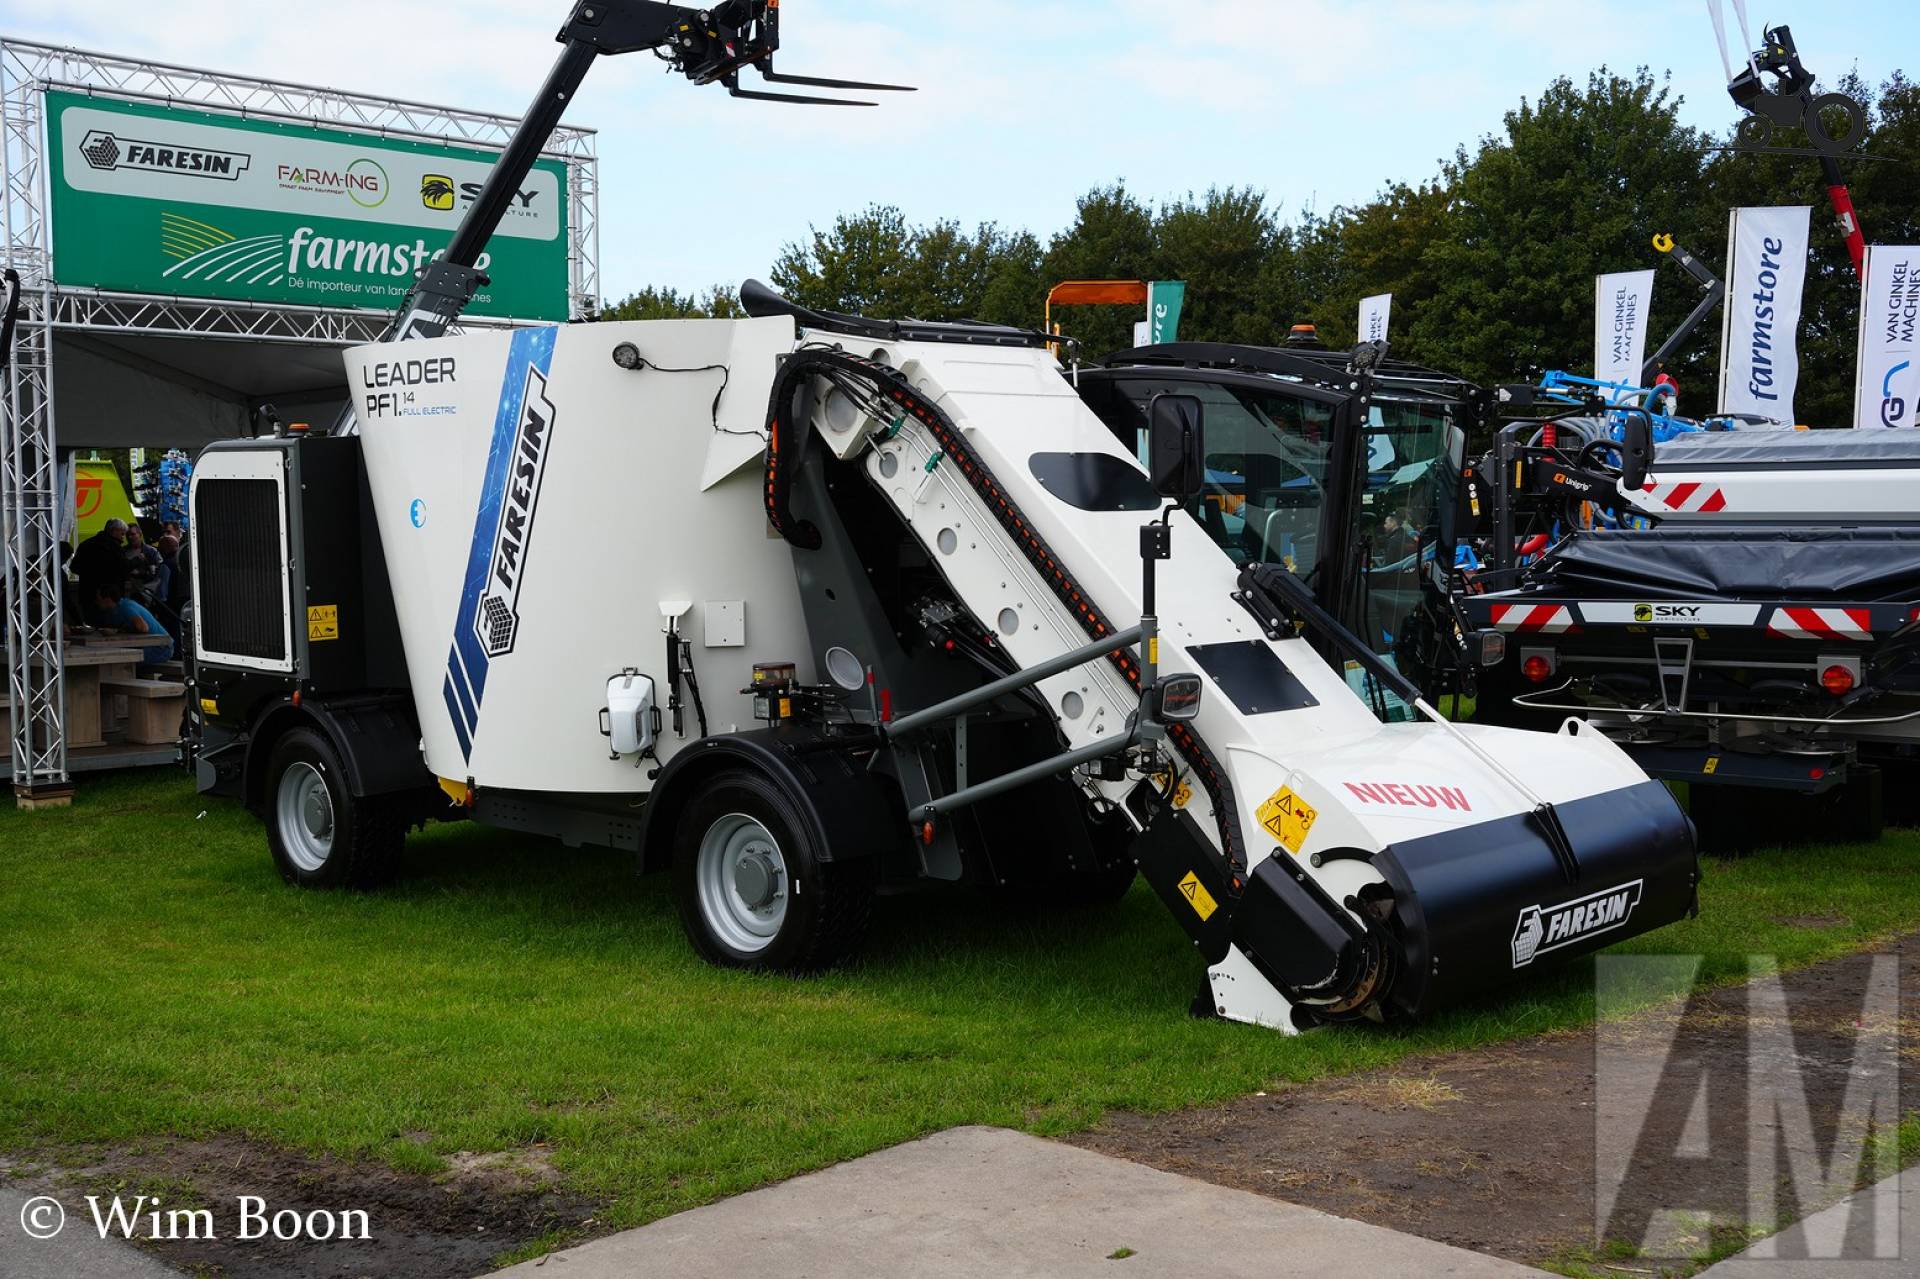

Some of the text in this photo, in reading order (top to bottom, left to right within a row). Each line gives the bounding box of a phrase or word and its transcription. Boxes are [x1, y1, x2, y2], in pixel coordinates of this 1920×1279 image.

[126, 145, 232, 174] FARESIN
[278, 165, 378, 191] FARM-ING
[460, 183, 540, 208] SY
[288, 277, 304, 288] Dé
[306, 280, 362, 294] importeur
[365, 284, 385, 295] van
[1886, 260, 1909, 344] VAN GINKEL
[1901, 269, 1920, 343] MACHINES
[1613, 285, 1627, 364] VAN GINKEL
[1750, 237, 1783, 400] farmstore
[363, 357, 456, 388] LEADER
[366, 391, 415, 418] PF1. 14
[403, 406, 457, 416] FULL ELECTRIC
[496, 405, 546, 592] FARESIN
[1655, 605, 1701, 617] SKY
[1343, 782, 1473, 812] NIEUW
[1544, 891, 1630, 944] FARESIN
